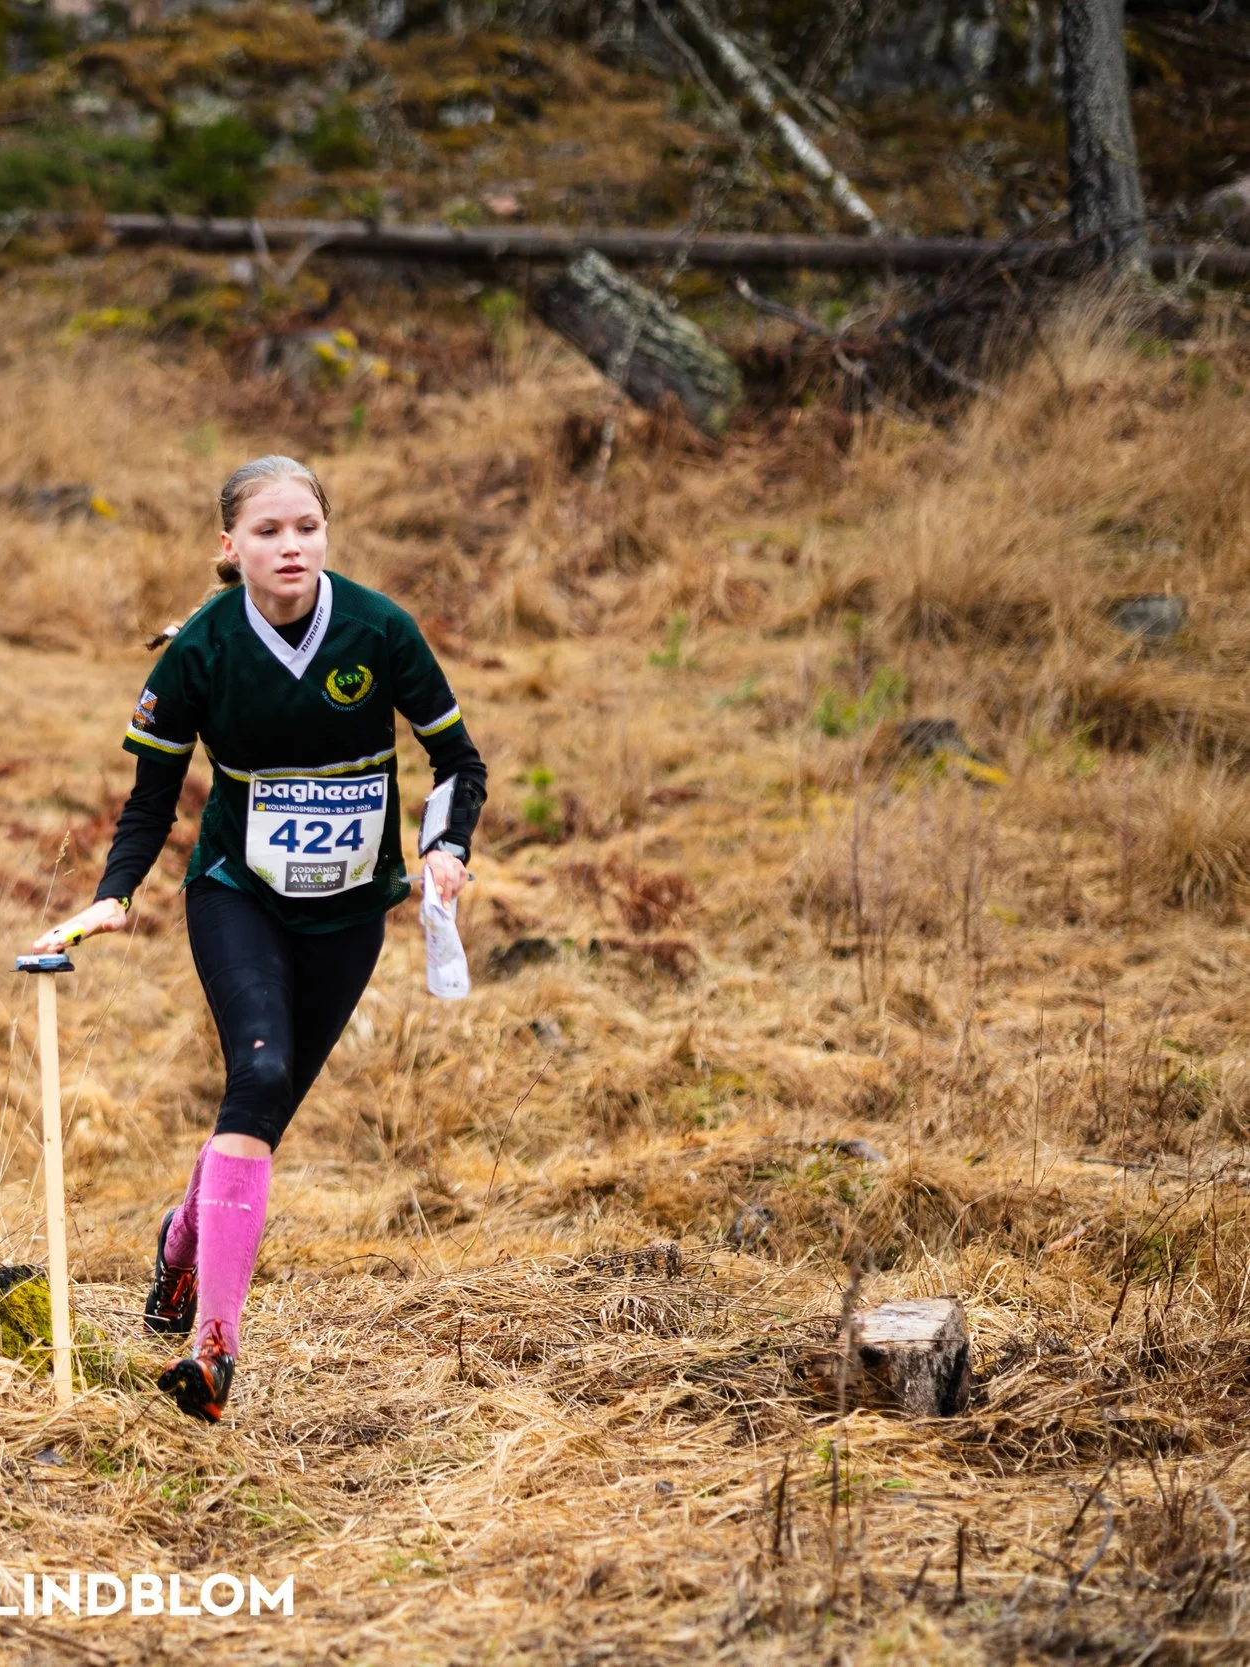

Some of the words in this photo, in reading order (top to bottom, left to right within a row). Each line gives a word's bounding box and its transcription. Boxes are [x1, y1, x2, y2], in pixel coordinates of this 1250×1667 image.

[301, 605, 325, 653] noname
[337, 673, 362, 687] SSK
[254, 780, 384, 803] bagheera
[356, 804, 372, 812] 2026
[269, 818, 365, 854] 424
[291, 865, 342, 874] GODKÄNDA
